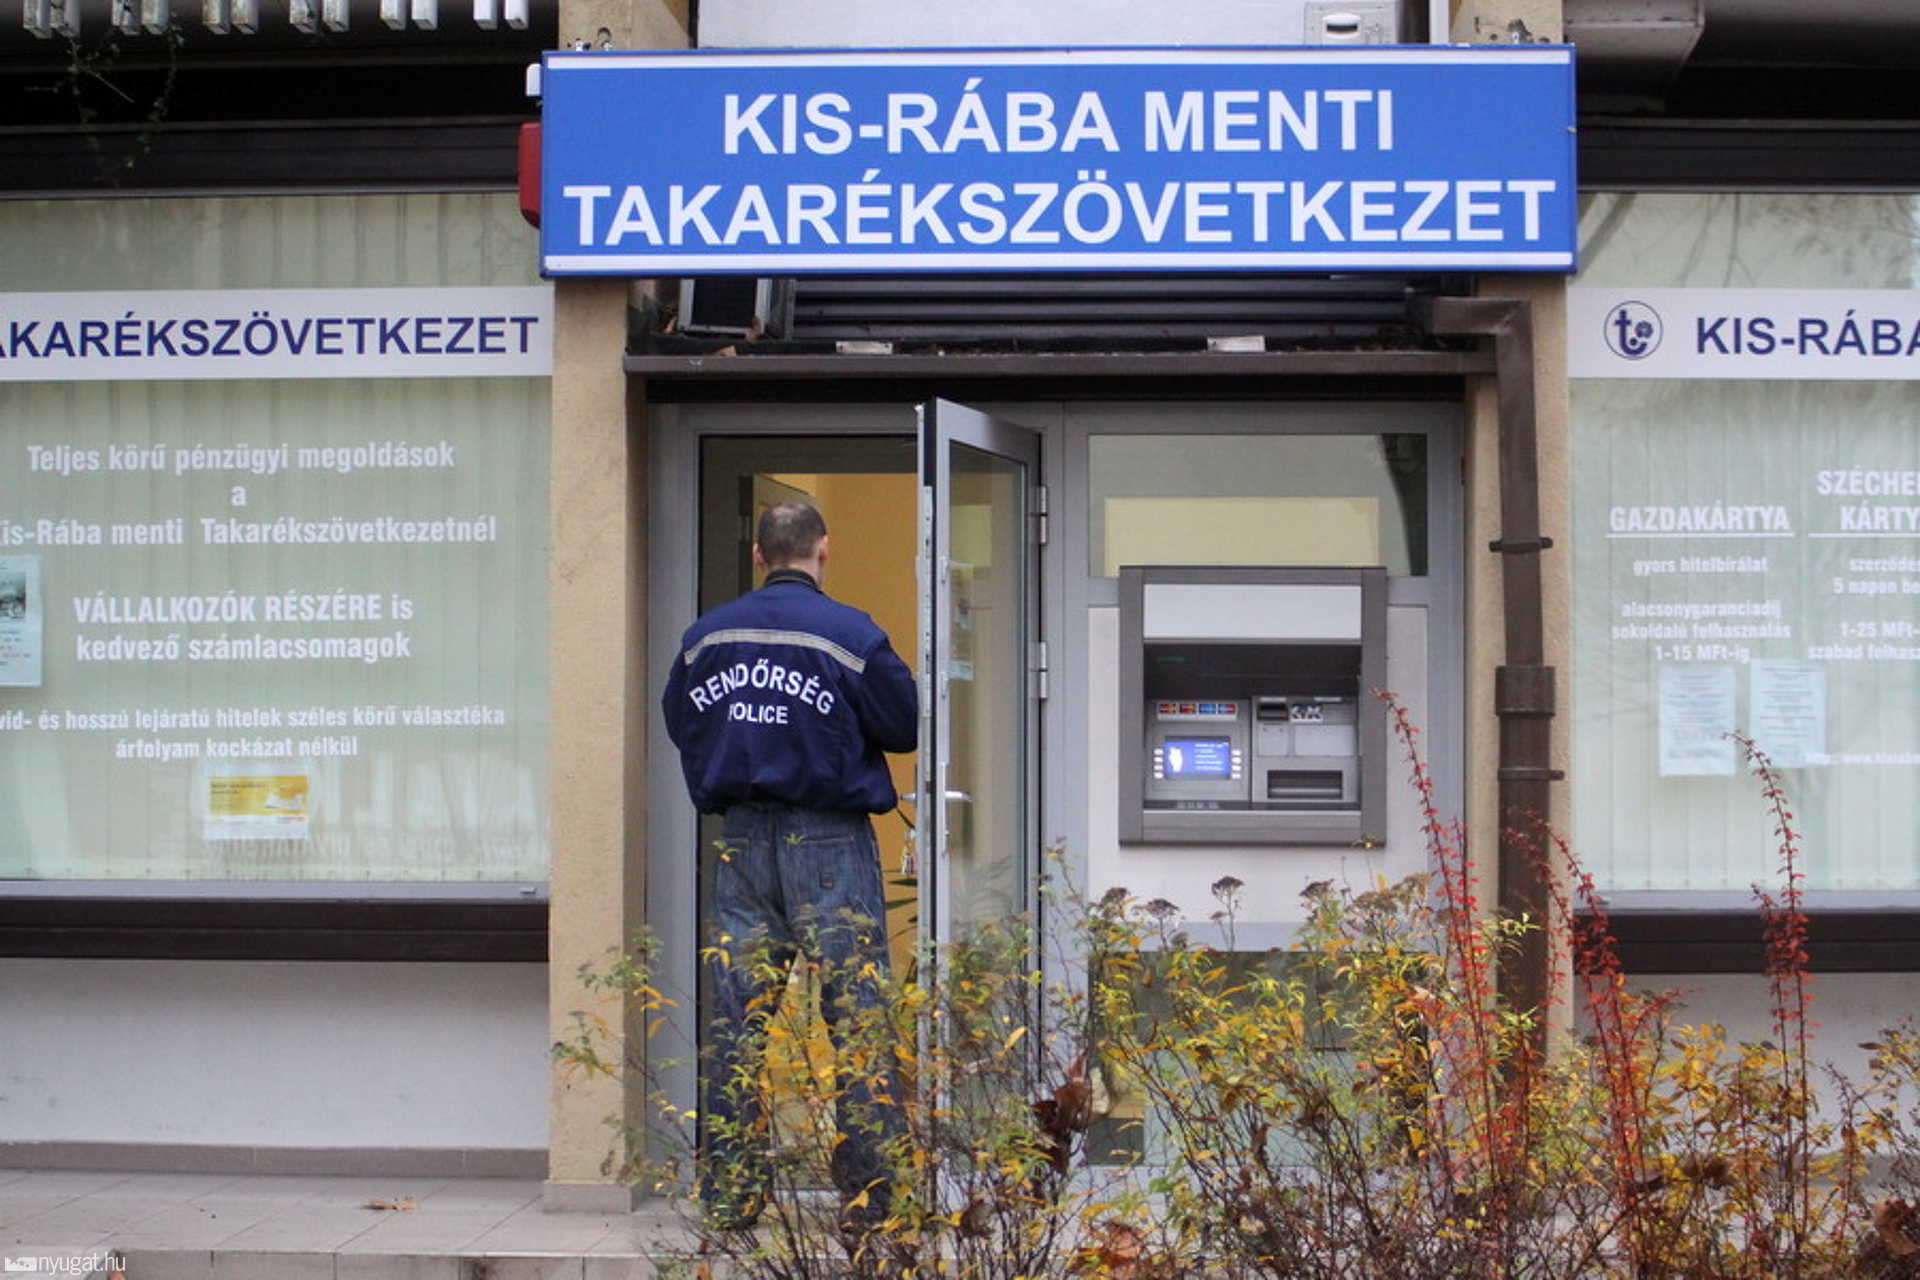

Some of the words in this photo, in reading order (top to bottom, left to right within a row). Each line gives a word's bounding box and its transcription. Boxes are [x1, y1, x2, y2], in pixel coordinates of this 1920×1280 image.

[723, 77, 1121, 155] KIS-RÁBA
[1144, 89, 1394, 153] MENTI
[563, 169, 1556, 247] TAKARÉKSZÖVETKEZET
[0, 310, 539, 358] KARÉKSZÖVETKEZET
[27, 445, 100, 476] Teljes
[109, 444, 166, 471] körű
[176, 443, 288, 476] pénzügyi
[298, 441, 455, 474] megoldások
[231, 486, 247, 507] a
[1816, 464, 1920, 497] SZÉCHE
[0, 518, 101, 546] is-Rába
[112, 517, 184, 545] menti
[201, 514, 497, 545] Takarékszövetkezetnél
[1609, 500, 1791, 533] GAZDAKÁRTYA
[1633, 559, 1676, 577] gyors
[1832, 577, 1844, 595] 5
[73, 589, 257, 624] VÁLLALKOZÓK
[265, 587, 383, 622] RÉSZÉRE
[391, 594, 414, 620] is
[77, 633, 180, 662] kedvező
[188, 631, 411, 664] számlacsomagok
[1655, 644, 1692, 662] 1-15
[1696, 643, 1751, 664] MFt-ig
[689, 658, 835, 715] RENDŐRSÉG
[38, 709, 60, 731] és
[66, 708, 129, 730] hosszú
[136, 707, 210, 733] lejáratú
[216, 706, 283, 730] hitelek
[288, 705, 347, 728] széles
[353, 704, 397, 727] körű
[402, 703, 505, 727] választéka
[115, 737, 201, 762] árfolyam
[206, 736, 294, 758] kockázat
[299, 735, 358, 757] nélkül
